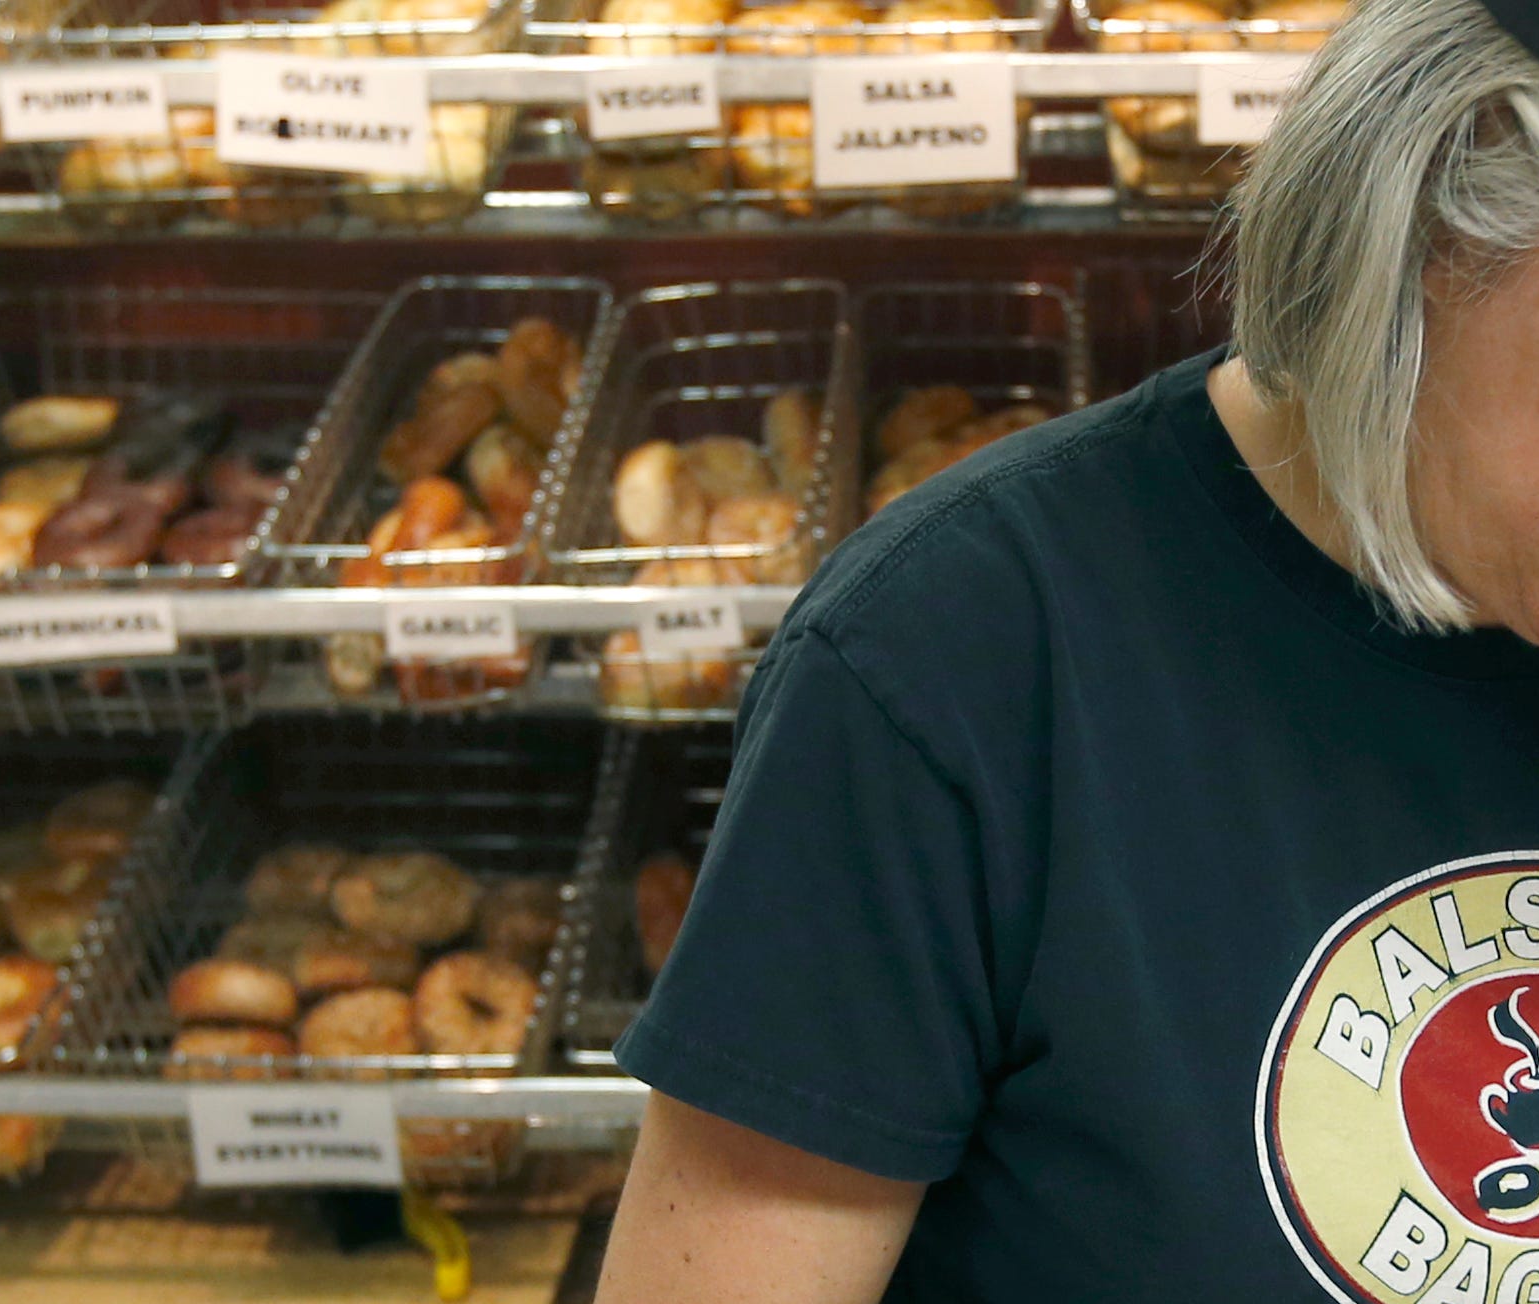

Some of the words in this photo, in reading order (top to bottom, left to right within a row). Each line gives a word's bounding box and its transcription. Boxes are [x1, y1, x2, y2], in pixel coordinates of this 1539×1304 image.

[280, 70, 365, 96] OLIVE
[863, 78, 956, 102] SALSA
[20, 86, 151, 112] PUMPKIN
[598, 84, 704, 111] VEGGIE
[834, 122, 989, 150] JALAPENO
[399, 616, 502, 638] GARLIC
[655, 607, 724, 632] SALT
[248, 1109, 340, 1129] WHEAT
[214, 1142, 381, 1162] EVERYTHING
